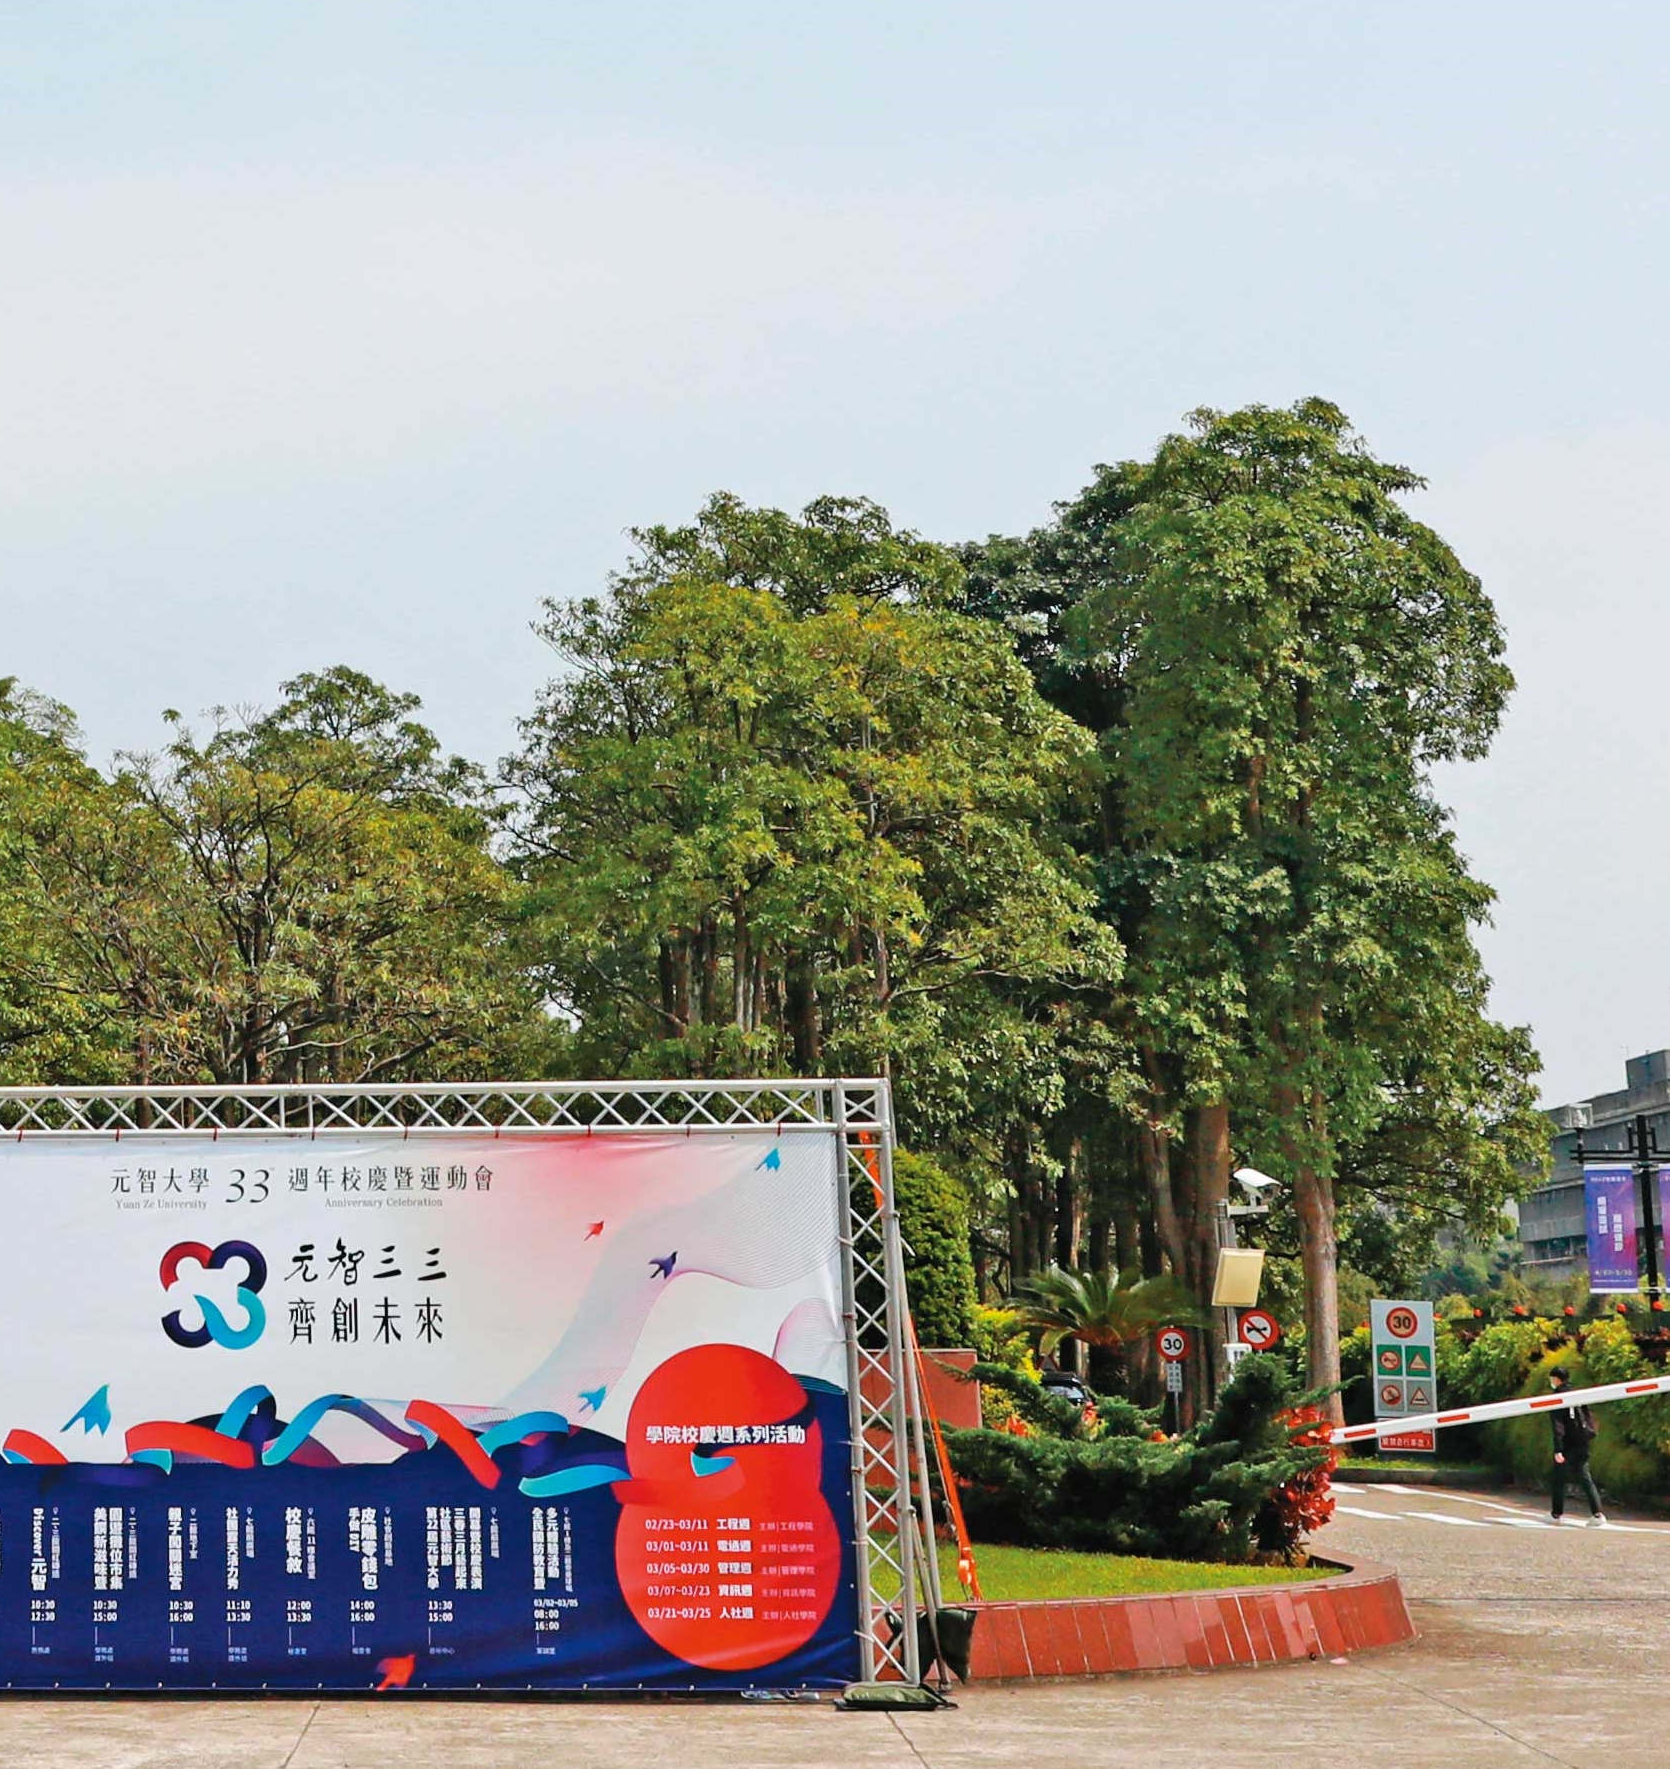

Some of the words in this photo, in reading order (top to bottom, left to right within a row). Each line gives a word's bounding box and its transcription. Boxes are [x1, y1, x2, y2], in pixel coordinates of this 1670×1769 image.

[110, 1166, 210, 1194] 元智大學
[287, 1164, 494, 1192] 週年校慶暨運動會
[116, 1199, 140, 1210] Yuan
[142, 1199, 155, 1209] Ze
[157, 1198, 207, 1210] University
[325, 1197, 383, 1208] Anniversary
[386, 1197, 444, 1207] Celebration
[283, 1237, 447, 1286] 元智三三
[288, 1296, 444, 1345] 齊創未來
[1393, 1315, 1412, 1329] 30
[1164, 1339, 1182, 1350] 30
[646, 1425, 806, 1445] 學院校慶週系列活動
[716, 1518, 751, 1531] 工程週
[32, 1507, 45, 1556] Discover
[109, 1507, 123, 1590] 園遊攤位市集
[717, 1562, 752, 1575] 管理週
[31, 1558, 47, 1591] 元智
[31, 1600, 56, 1610] 10:30
[93, 1600, 118, 1610] 10:30
[169, 1601, 193, 1610] 10:30
[226, 1600, 251, 1610] 11:10
[286, 1601, 311, 1610] 12:00
[350, 1601, 375, 1610] 14:00
[428, 1601, 453, 1610] 13:30
[31, 1612, 56, 1621] 12:30
[93, 1612, 118, 1621] 15:00
[169, 1612, 193, 1622] 16:00
[226, 1612, 251, 1621] 13:30
[286, 1612, 311, 1622] 13:30
[350, 1612, 375, 1622] 16:00
[428, 1612, 453, 1622] 15:00
[533, 1610, 559, 1619] 08:00
[719, 1606, 754, 1619] 人社週
[534, 1621, 560, 1631] 16:00
